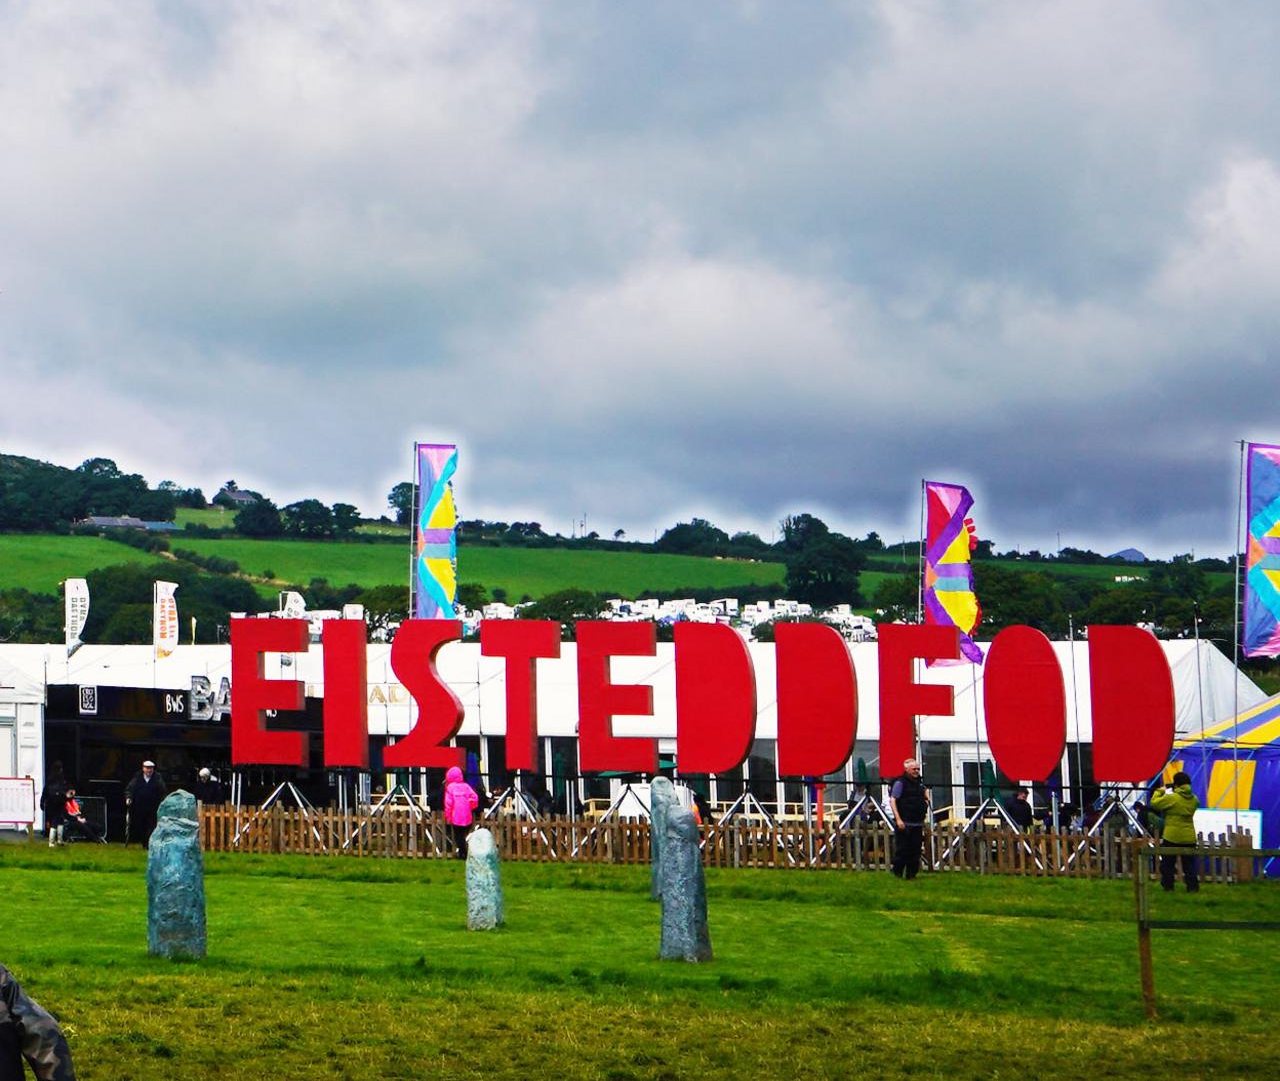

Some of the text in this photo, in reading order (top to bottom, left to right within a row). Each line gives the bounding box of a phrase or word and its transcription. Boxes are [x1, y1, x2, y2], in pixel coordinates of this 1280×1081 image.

[165, 693, 184, 713] BWS
[190, 675, 231, 721] BA
[231, 618, 1176, 783] EISTEDDFOD
